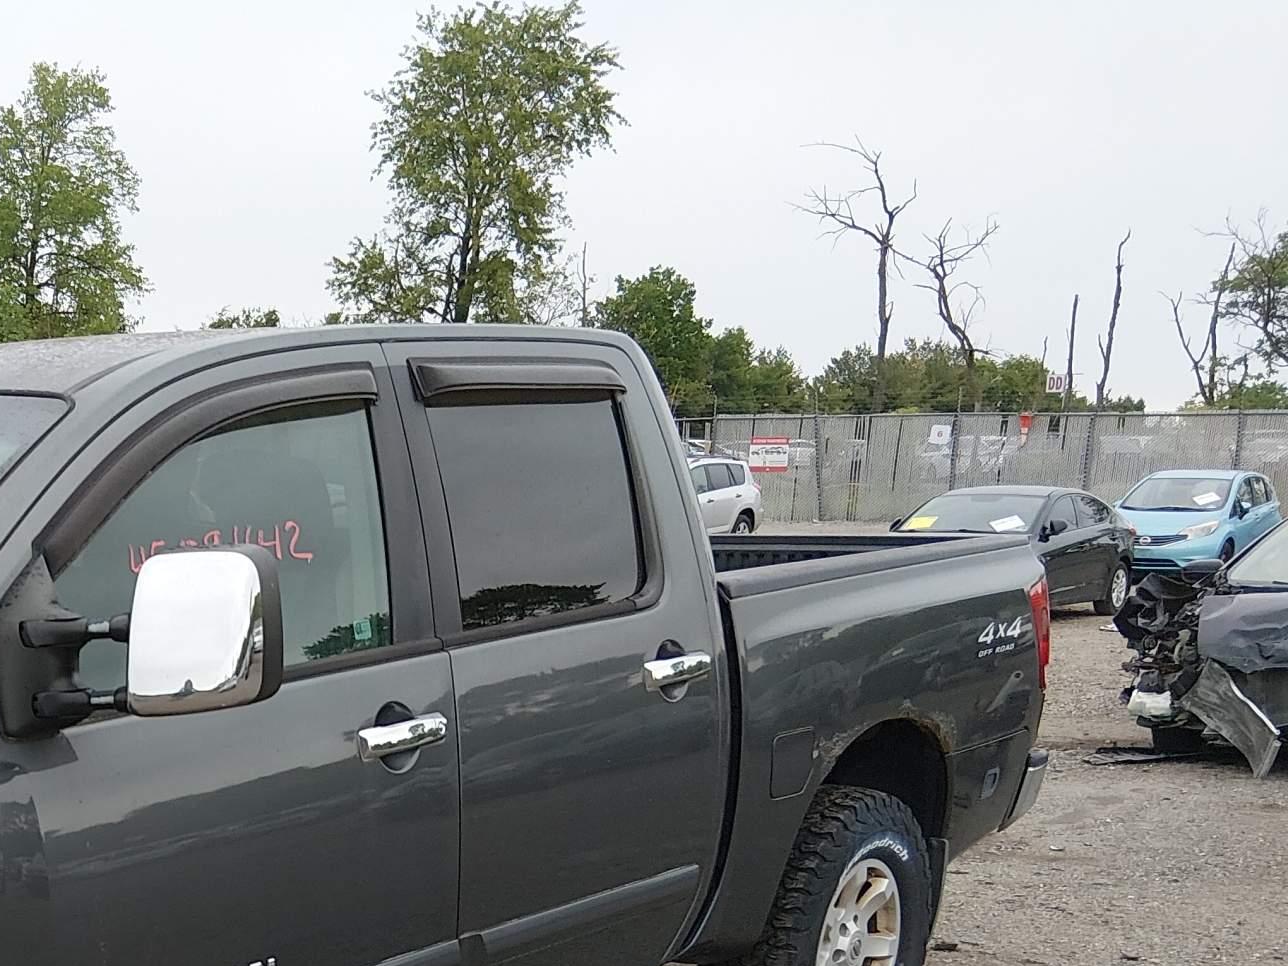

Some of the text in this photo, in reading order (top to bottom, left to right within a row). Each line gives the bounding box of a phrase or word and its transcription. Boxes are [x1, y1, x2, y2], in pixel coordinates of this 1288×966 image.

[1048, 376, 1063, 391] DD
[978, 643, 1015, 658] OFF ROAD
